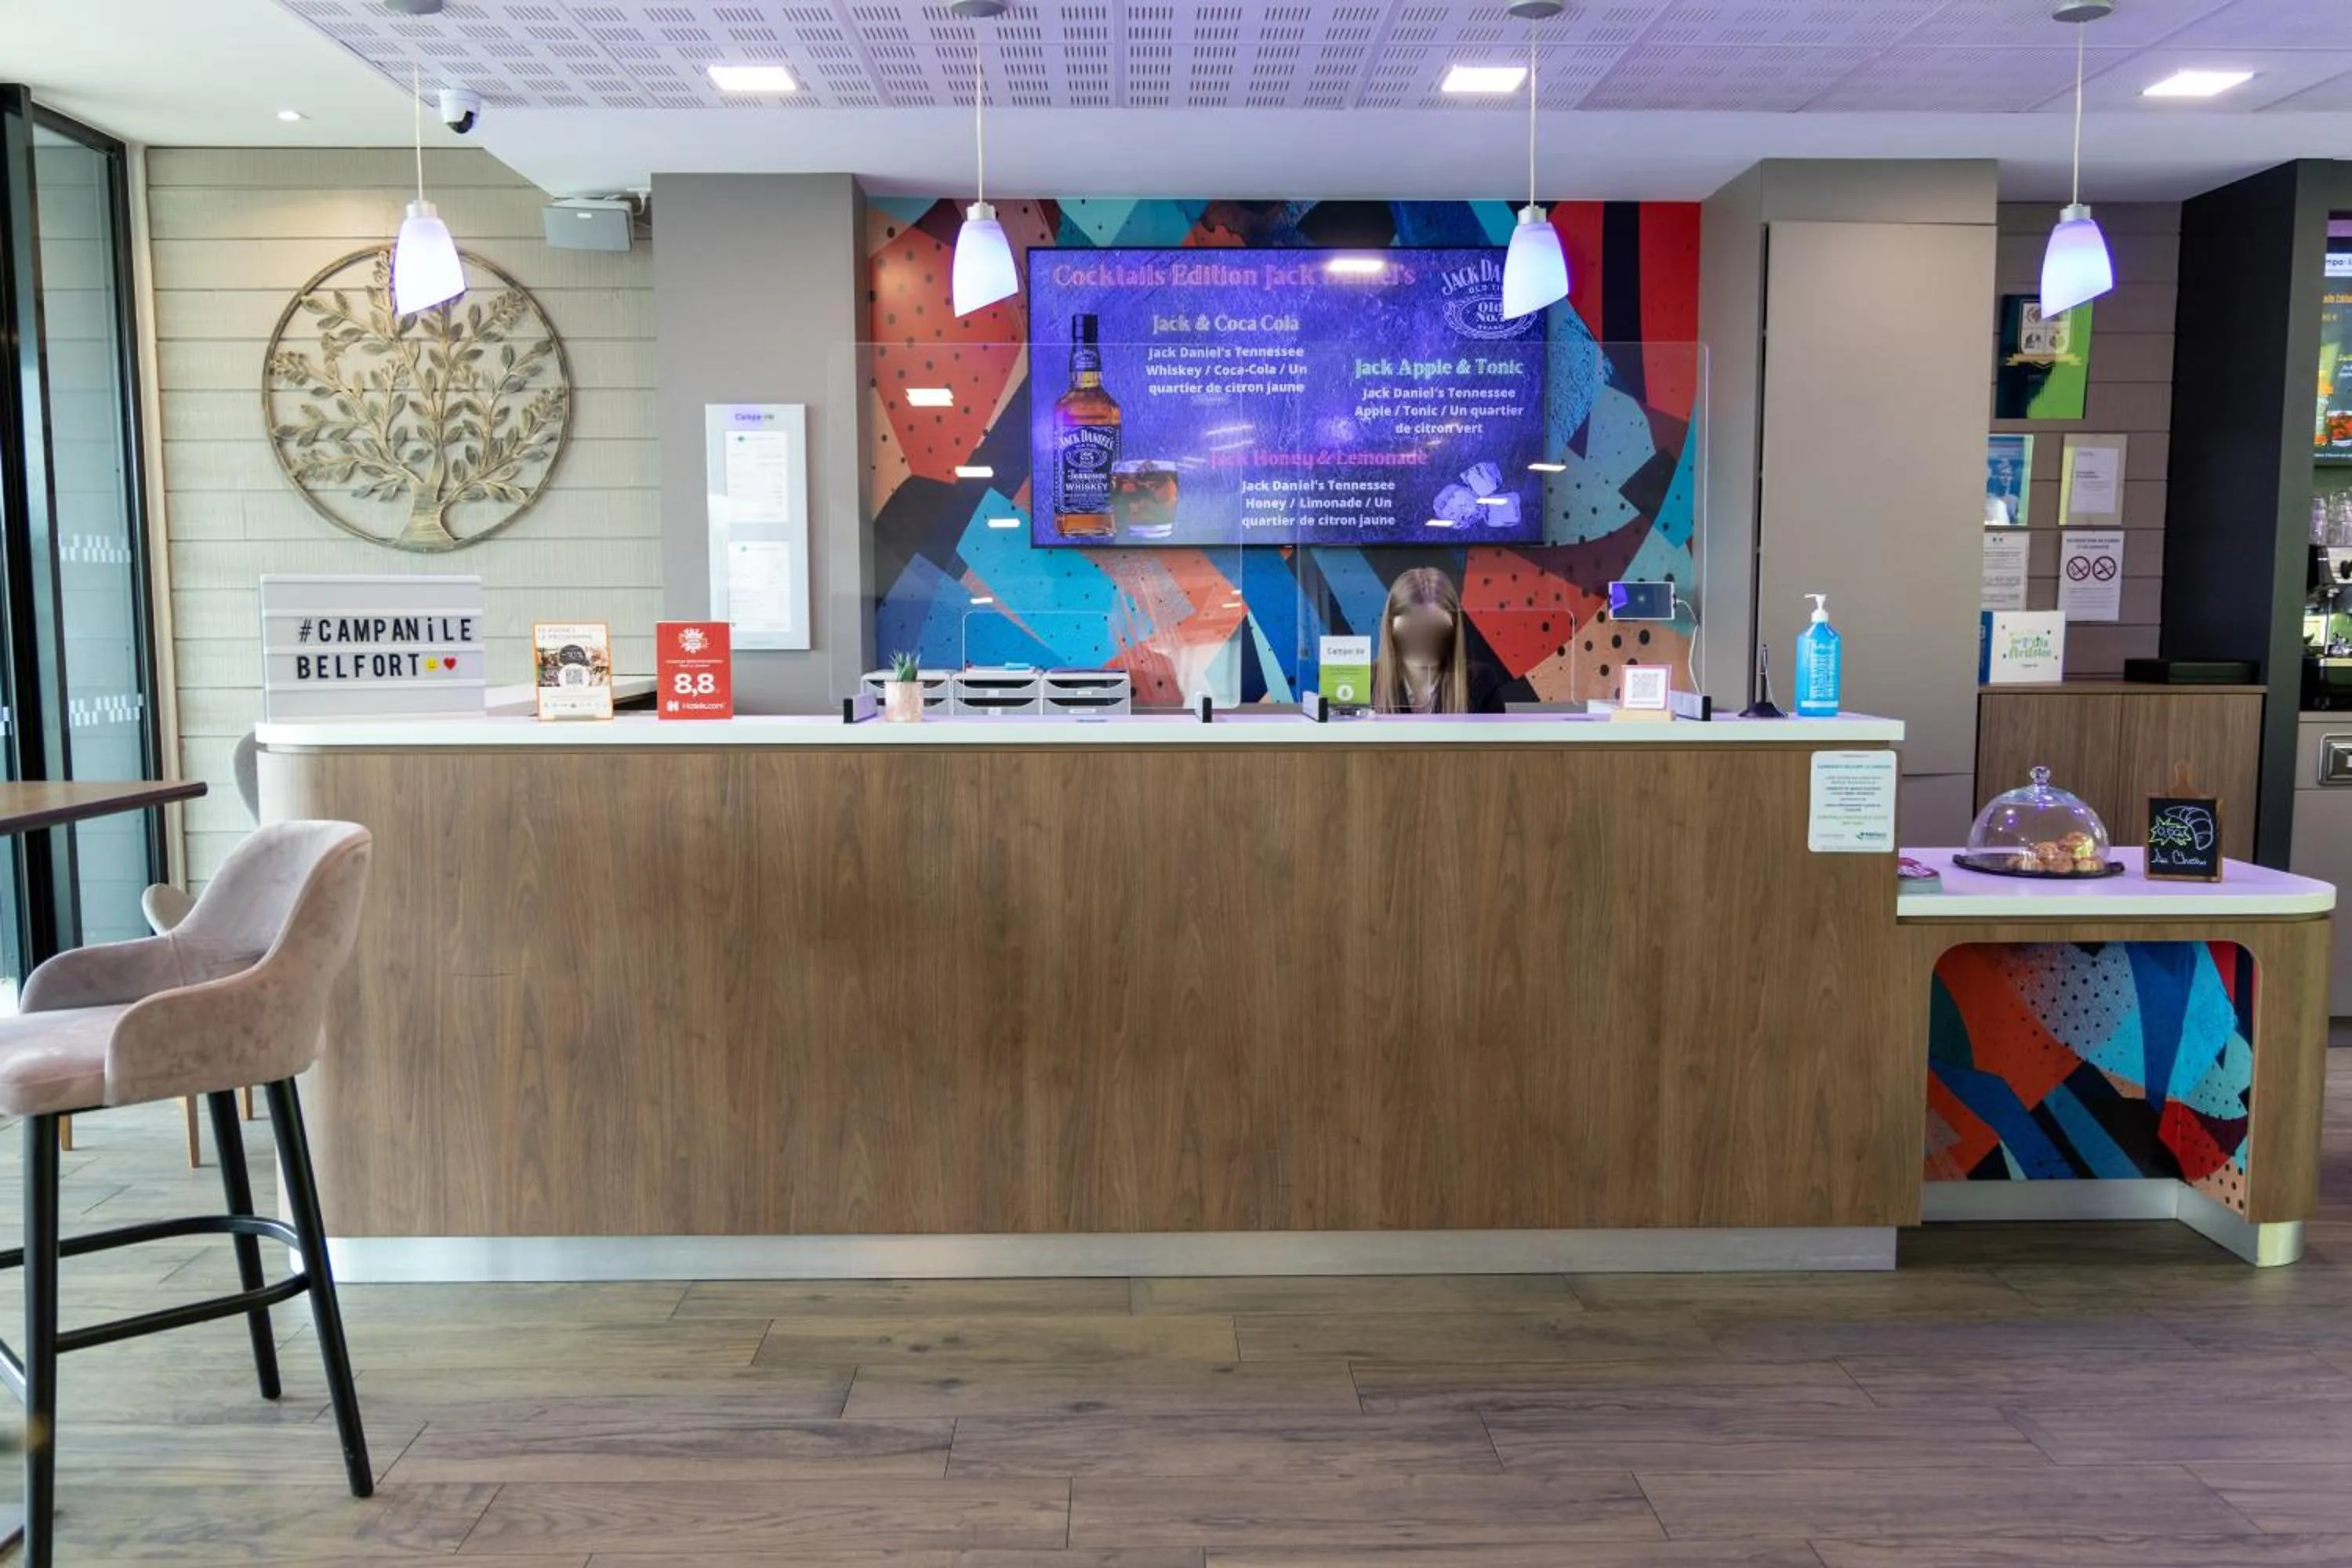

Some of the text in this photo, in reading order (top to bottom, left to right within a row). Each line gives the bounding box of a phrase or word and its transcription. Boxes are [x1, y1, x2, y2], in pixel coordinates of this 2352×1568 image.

[1053, 263, 1166, 286] Cocktails
[1171, 263, 1258, 285] Edition
[1263, 263, 1316, 290] Jack
[1442, 266, 1479, 296] JACK
[1152, 314, 1300, 336] Jack & Coca Cola
[1147, 346, 1305, 361] Jack Daniel's Tennessee
[1145, 363, 1308, 379] Whiskey / Coca-Cola / Un
[1355, 358, 1524, 380] Jack Apple & Tonic
[1148, 382, 1306, 395] quartier de citron jaune
[1361, 387, 1516, 401] Jack Daniel's Tennessee
[1355, 405, 1524, 419] Apple / Tonic / Un quartier
[1396, 423, 1483, 434] de citron vert
[1254, 451, 1314, 470] Honey
[1317, 450, 1332, 465] &
[1242, 479, 1396, 493] Jack Daniel's Tennessee
[1246, 497, 1392, 511] Honey / Limonade / Un
[1242, 514, 1396, 529] quartier de citron jaune
[296, 652, 420, 680] BELFORT
[674, 672, 716, 697] 8,8
